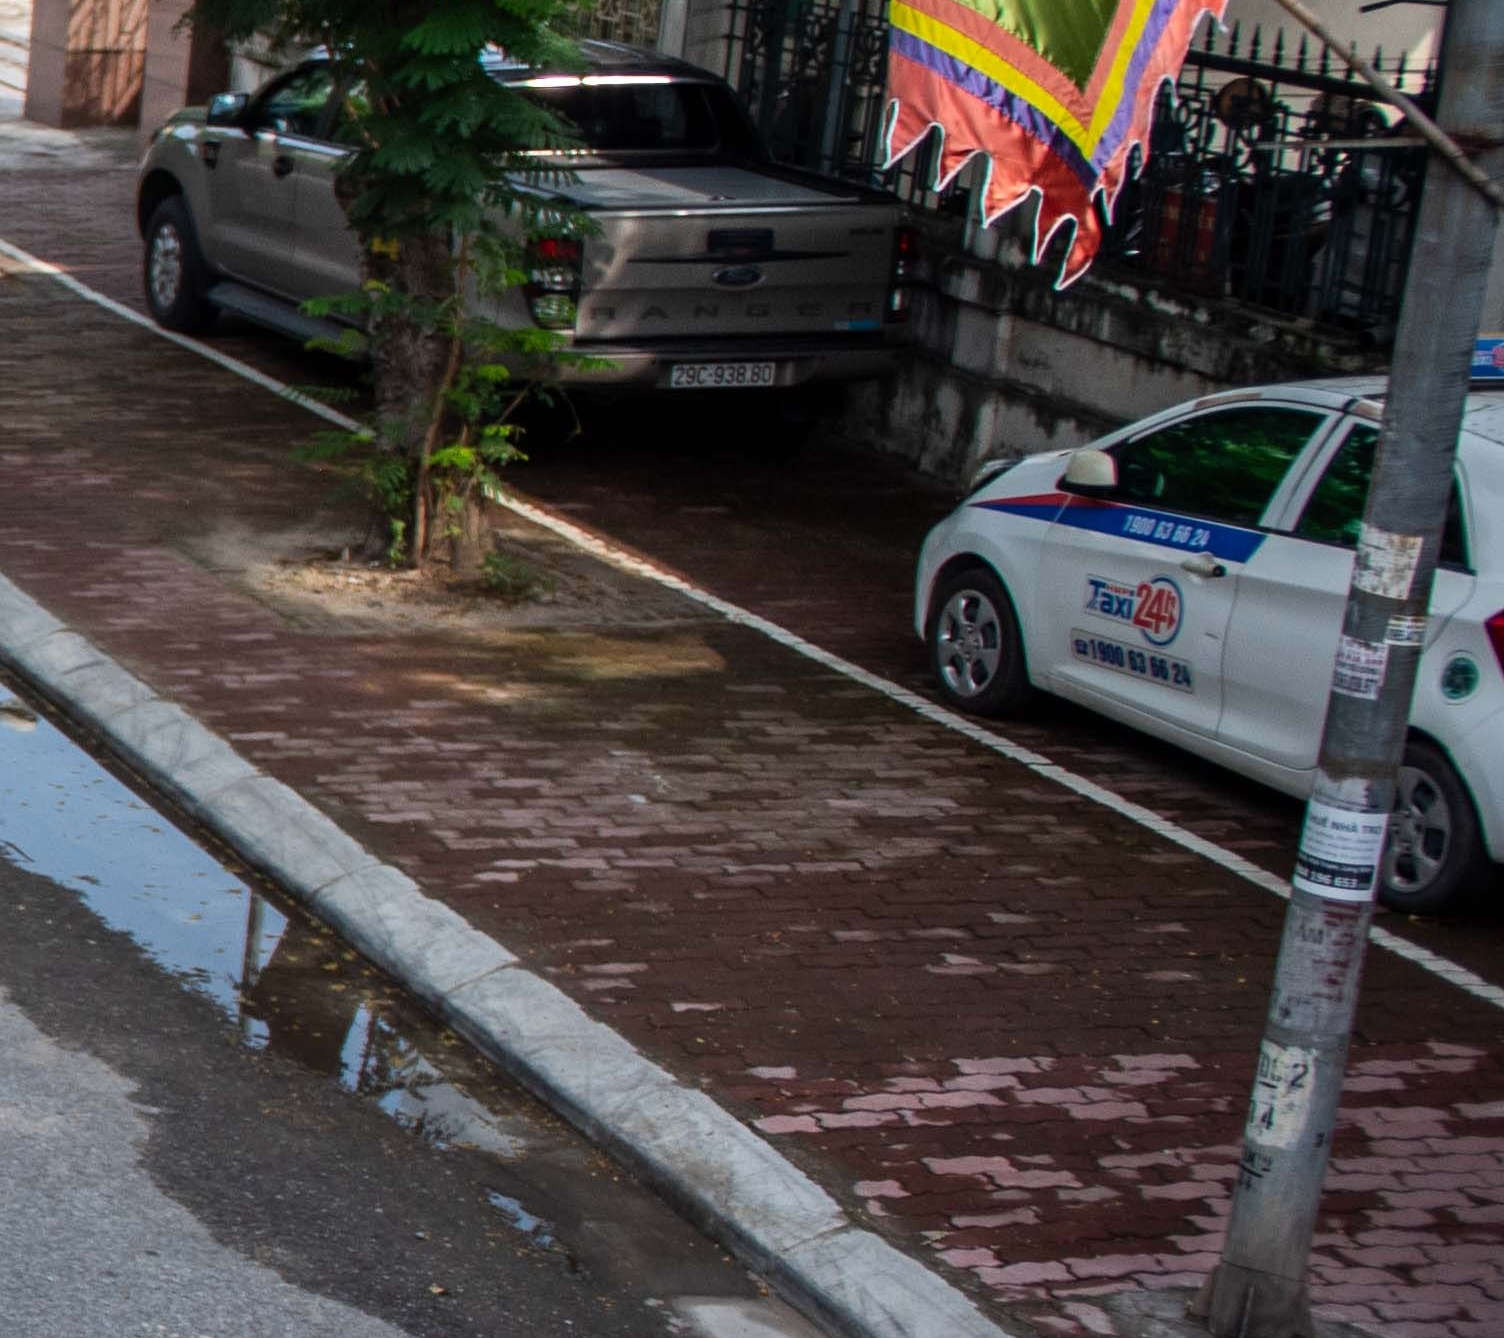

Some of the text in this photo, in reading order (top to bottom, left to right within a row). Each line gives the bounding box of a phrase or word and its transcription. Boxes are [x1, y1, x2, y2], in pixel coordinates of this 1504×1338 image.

[590, 301, 873, 322] RANGER
[673, 364, 772, 387] 29C-938.80
[1123, 515, 1212, 549] 1900 63 66 24
[1086, 578, 1134, 621] Taxi
[1091, 639, 1192, 688] 1900 63 66 24
